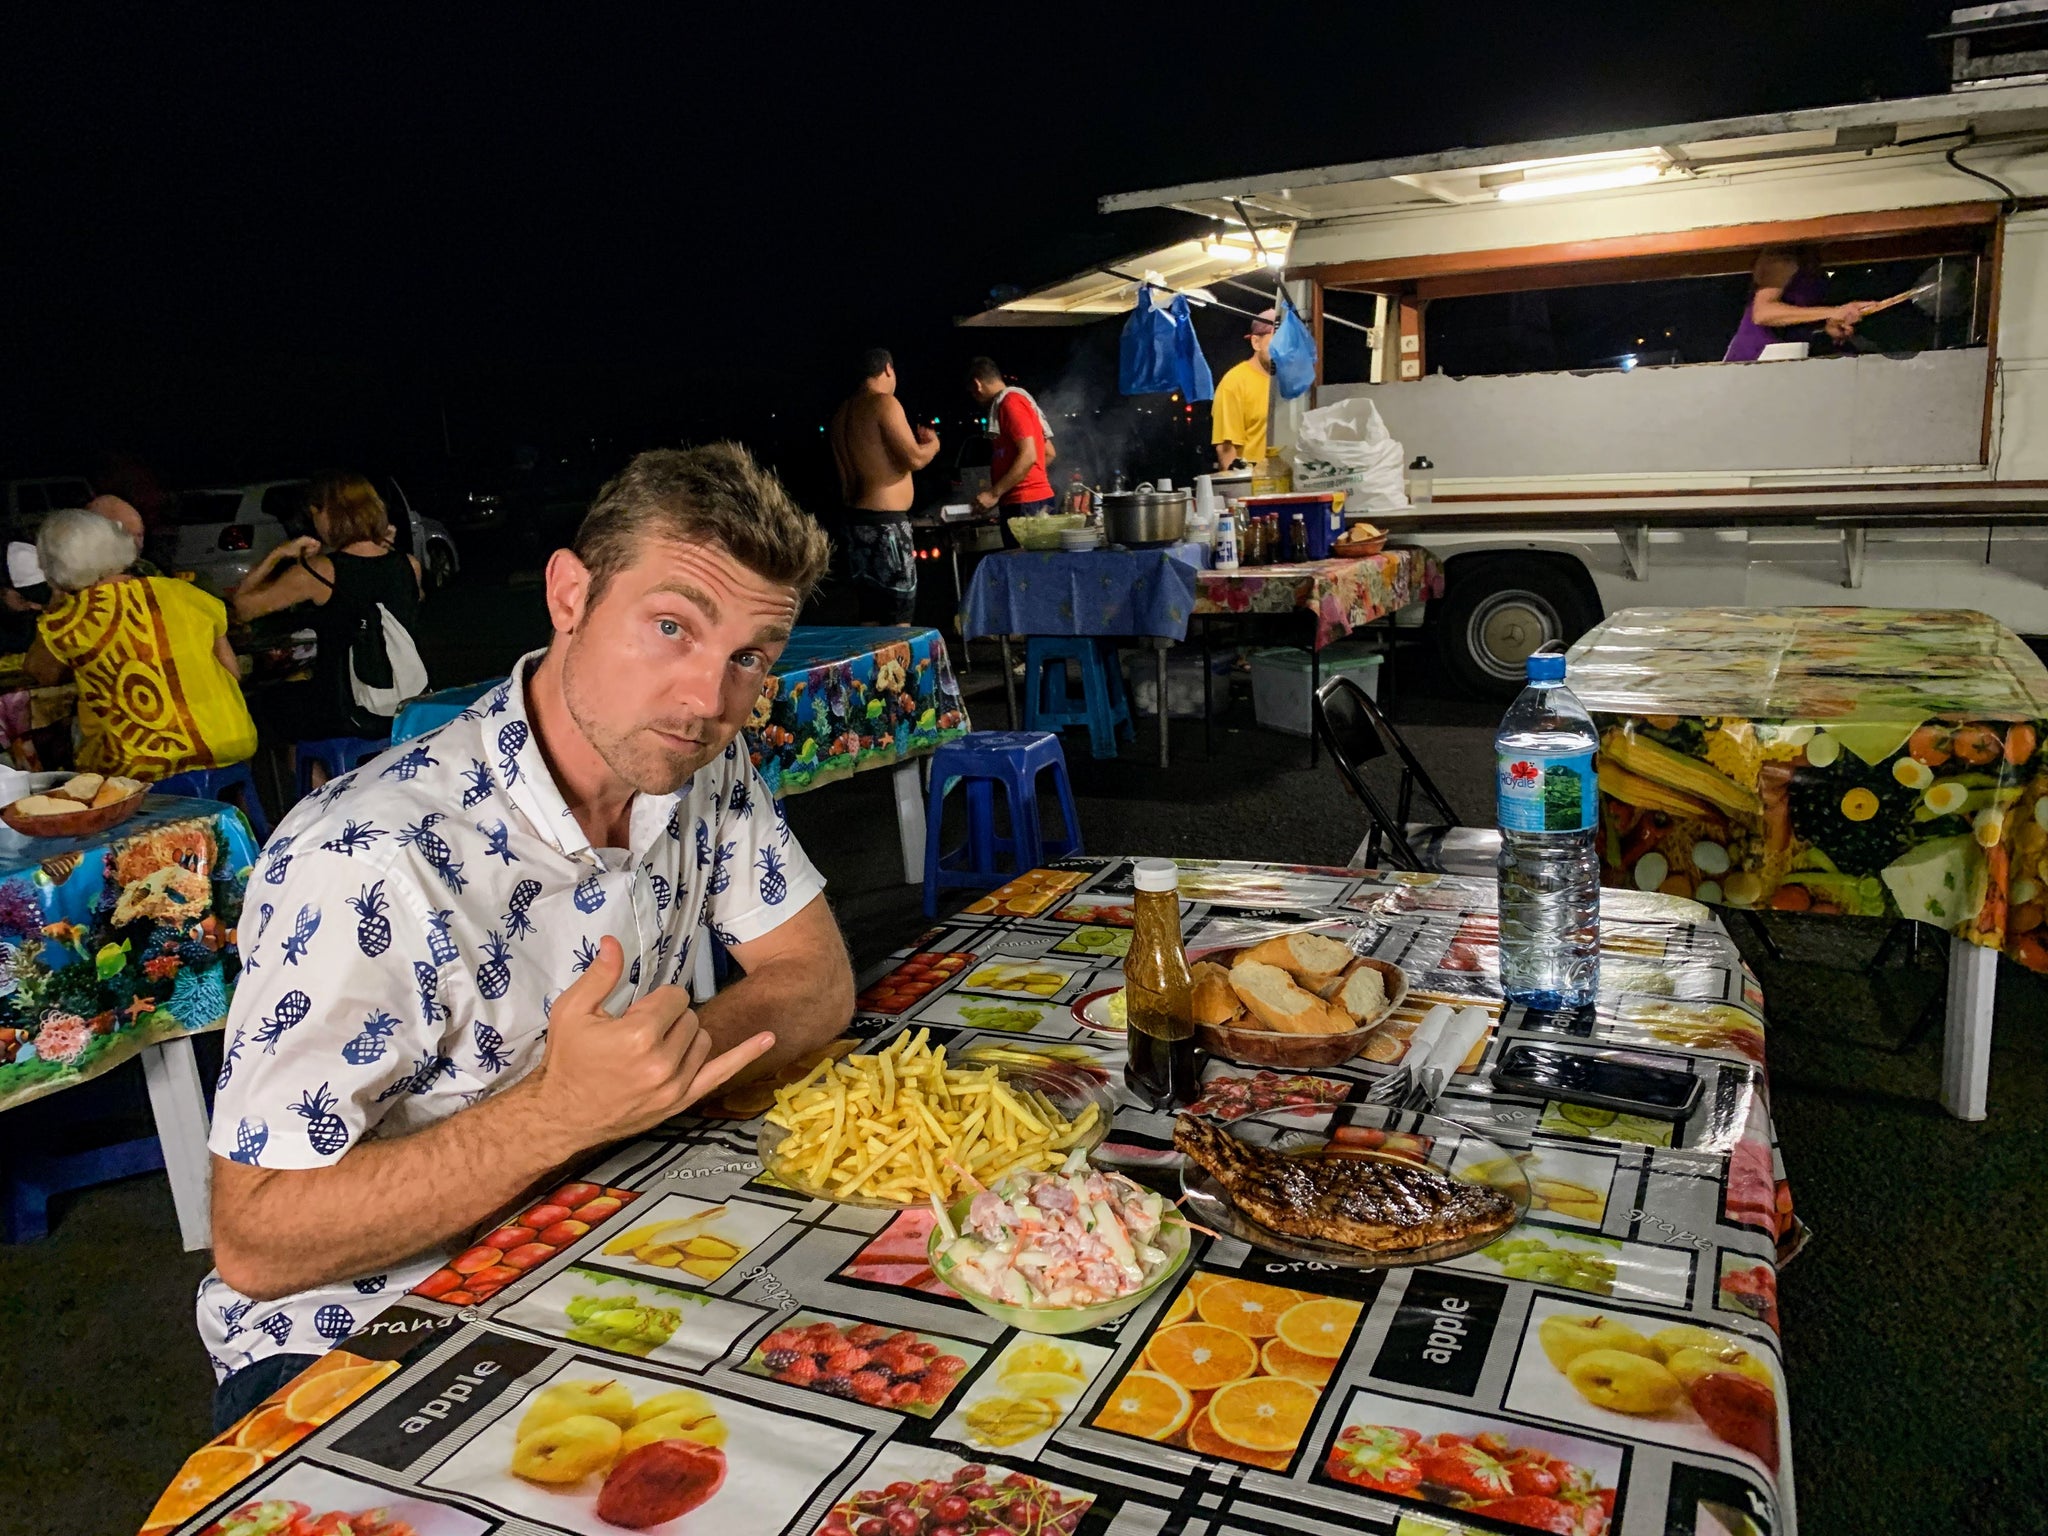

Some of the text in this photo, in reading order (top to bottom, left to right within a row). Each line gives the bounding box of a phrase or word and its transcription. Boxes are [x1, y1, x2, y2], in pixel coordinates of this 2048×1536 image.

[1501, 773, 1535, 789] Royale
[1240, 908, 1281, 918] kiwi
[1621, 1208, 1713, 1251] grape
[740, 1264, 799, 1311] grape
[1422, 1297, 1470, 1365] apple
[399, 1360, 502, 1434] apple
